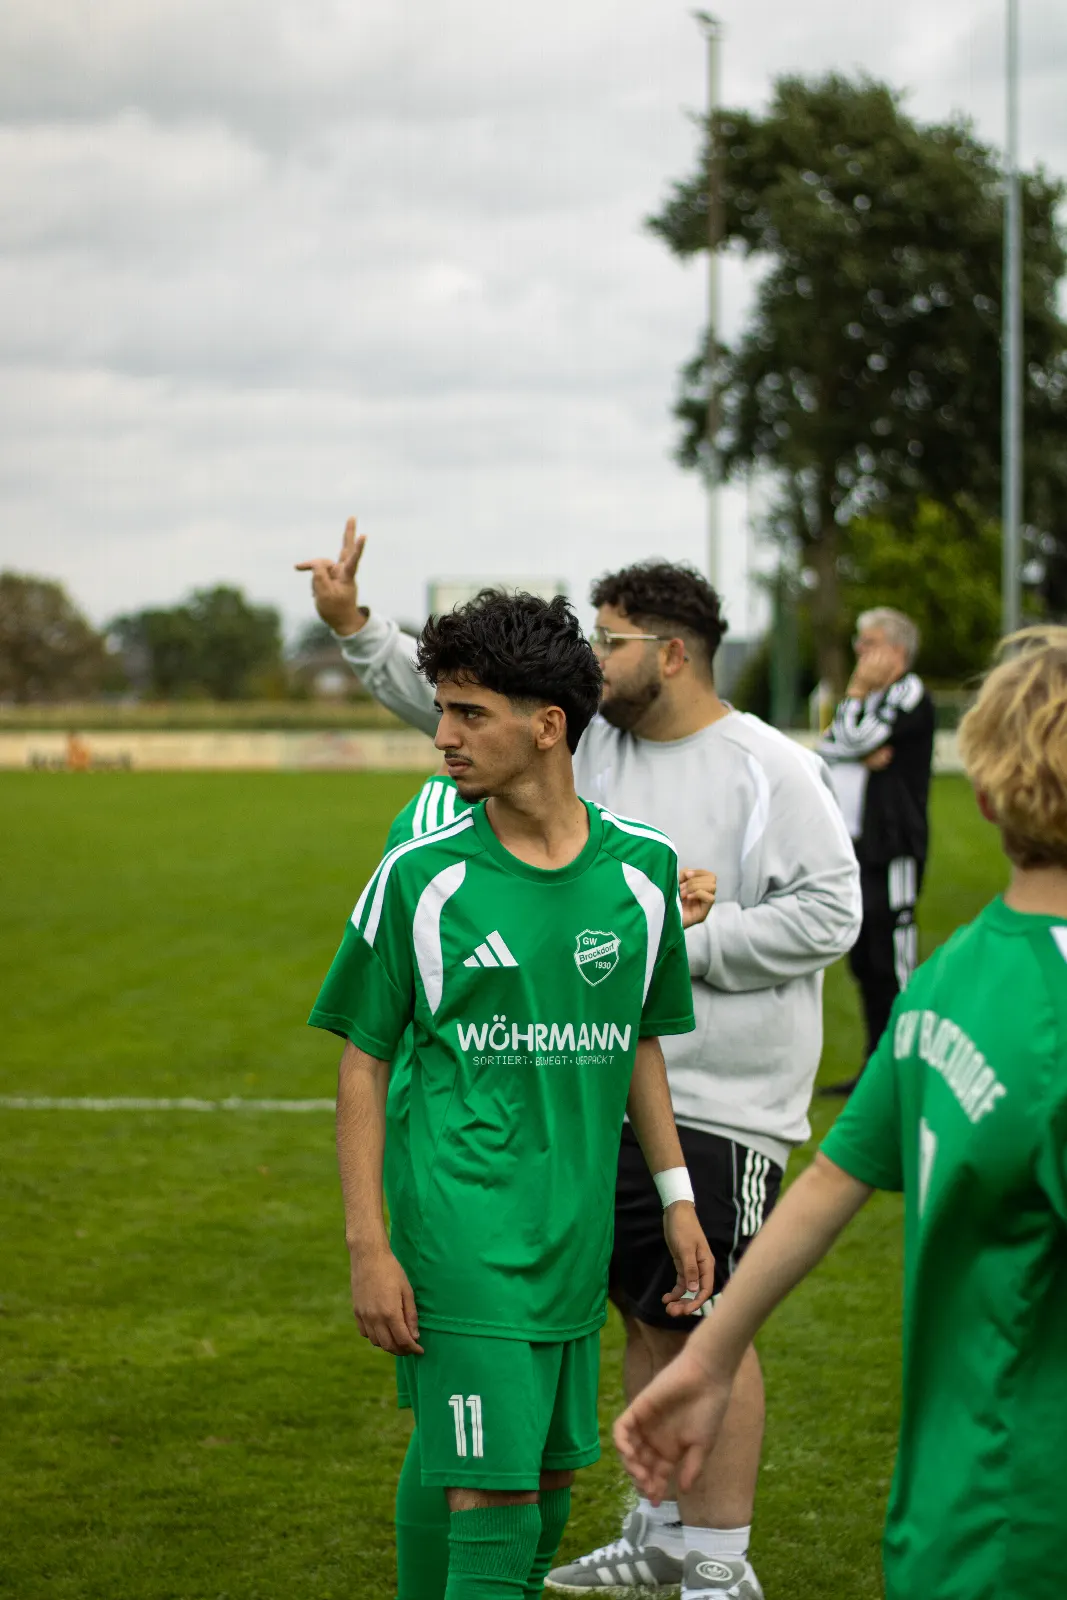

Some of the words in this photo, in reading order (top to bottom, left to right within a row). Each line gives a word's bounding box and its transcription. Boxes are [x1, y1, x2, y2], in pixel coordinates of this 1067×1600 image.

[582, 936, 597, 945] GW
[578, 942, 615, 963] Brockdorf
[595, 960, 612, 970] 1930
[456, 1014, 632, 1052] WÖHRMANN
[472, 1055, 527, 1066] SORTIERT
[448, 1394, 484, 1458] 11
